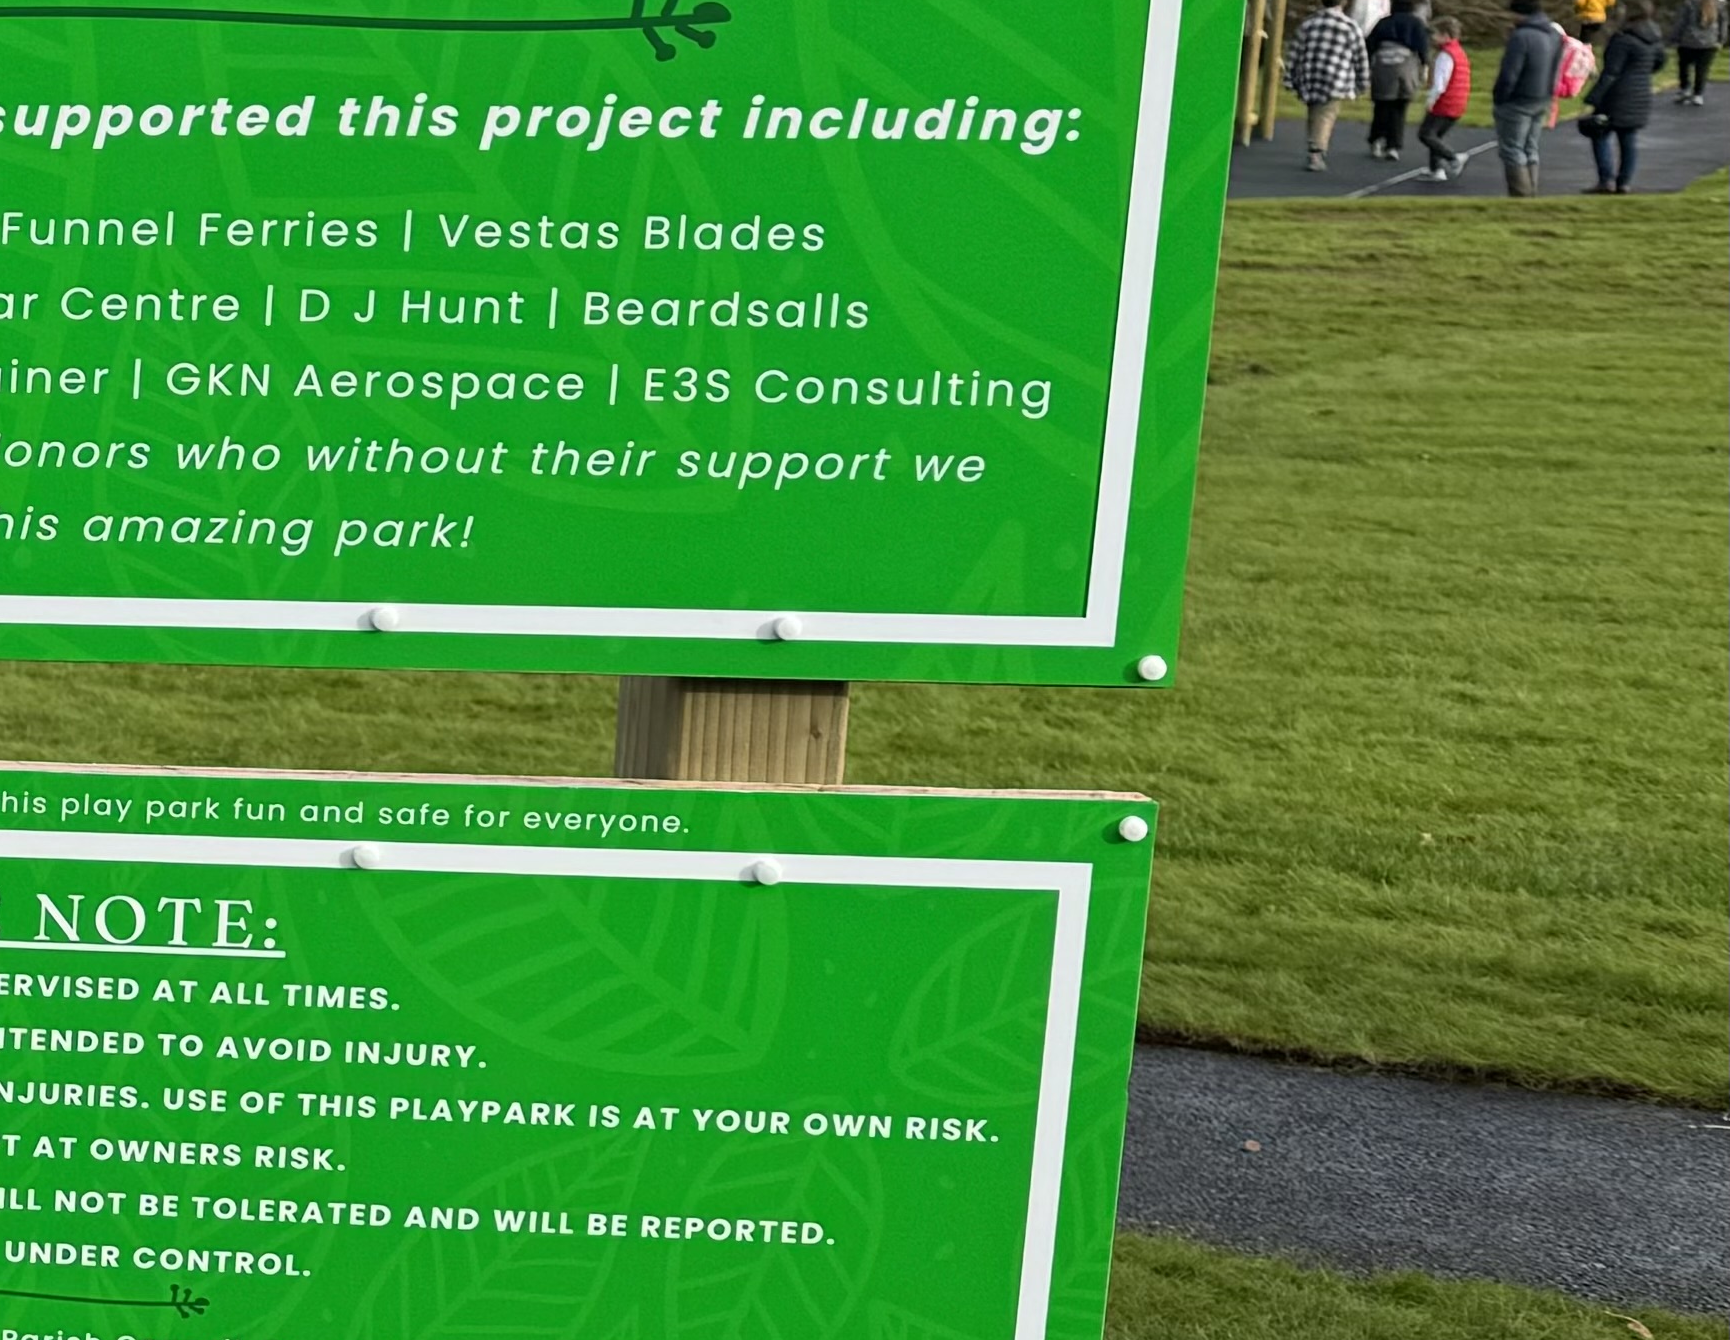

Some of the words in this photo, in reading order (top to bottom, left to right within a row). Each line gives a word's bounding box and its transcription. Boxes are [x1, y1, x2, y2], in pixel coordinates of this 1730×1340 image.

[337, 91, 460, 138] this
[477, 92, 724, 153] project
[741, 93, 1083, 157] including:
[0, 209, 175, 247] Funnel
[198, 209, 379, 248] Ferries
[437, 213, 620, 251] Vestas
[643, 213, 826, 253] Blades
[59, 286, 241, 323] Centre
[298, 288, 331, 323] D
[352, 288, 376, 324] J
[400, 289, 526, 325] Hunt
[582, 290, 870, 330] Beardsalls
[165, 361, 271, 398] GKN
[292, 363, 585, 412] Aerospace
[643, 365, 732, 404] E3S
[754, 368, 1053, 421] Consulting
[176, 434, 282, 472] who
[306, 435, 510, 475] without
[530, 439, 658, 478] their
[675, 447, 893, 492] support
[914, 453, 986, 484] we
[32, 892, 279, 950] NOTE:
[151, 978, 199, 1004] AT
[208, 980, 271, 1007] ALL
[281, 983, 401, 1012] TIMES.
[156, 1032, 205, 1059] TO
[215, 1035, 333, 1063] AVOID
[343, 1039, 488, 1070] INJURY.
[162, 1086, 228, 1113] USE
[238, 1090, 286, 1116] OF
[296, 1092, 378, 1120] THIS
[388, 1096, 577, 1128] PLAYPARK
[587, 1103, 622, 1130] IS
[631, 1105, 681, 1132] AT
[691, 1107, 792, 1136] YOUR
[802, 1111, 893, 1140] OWN
[904, 1115, 1000, 1144] RISK.
